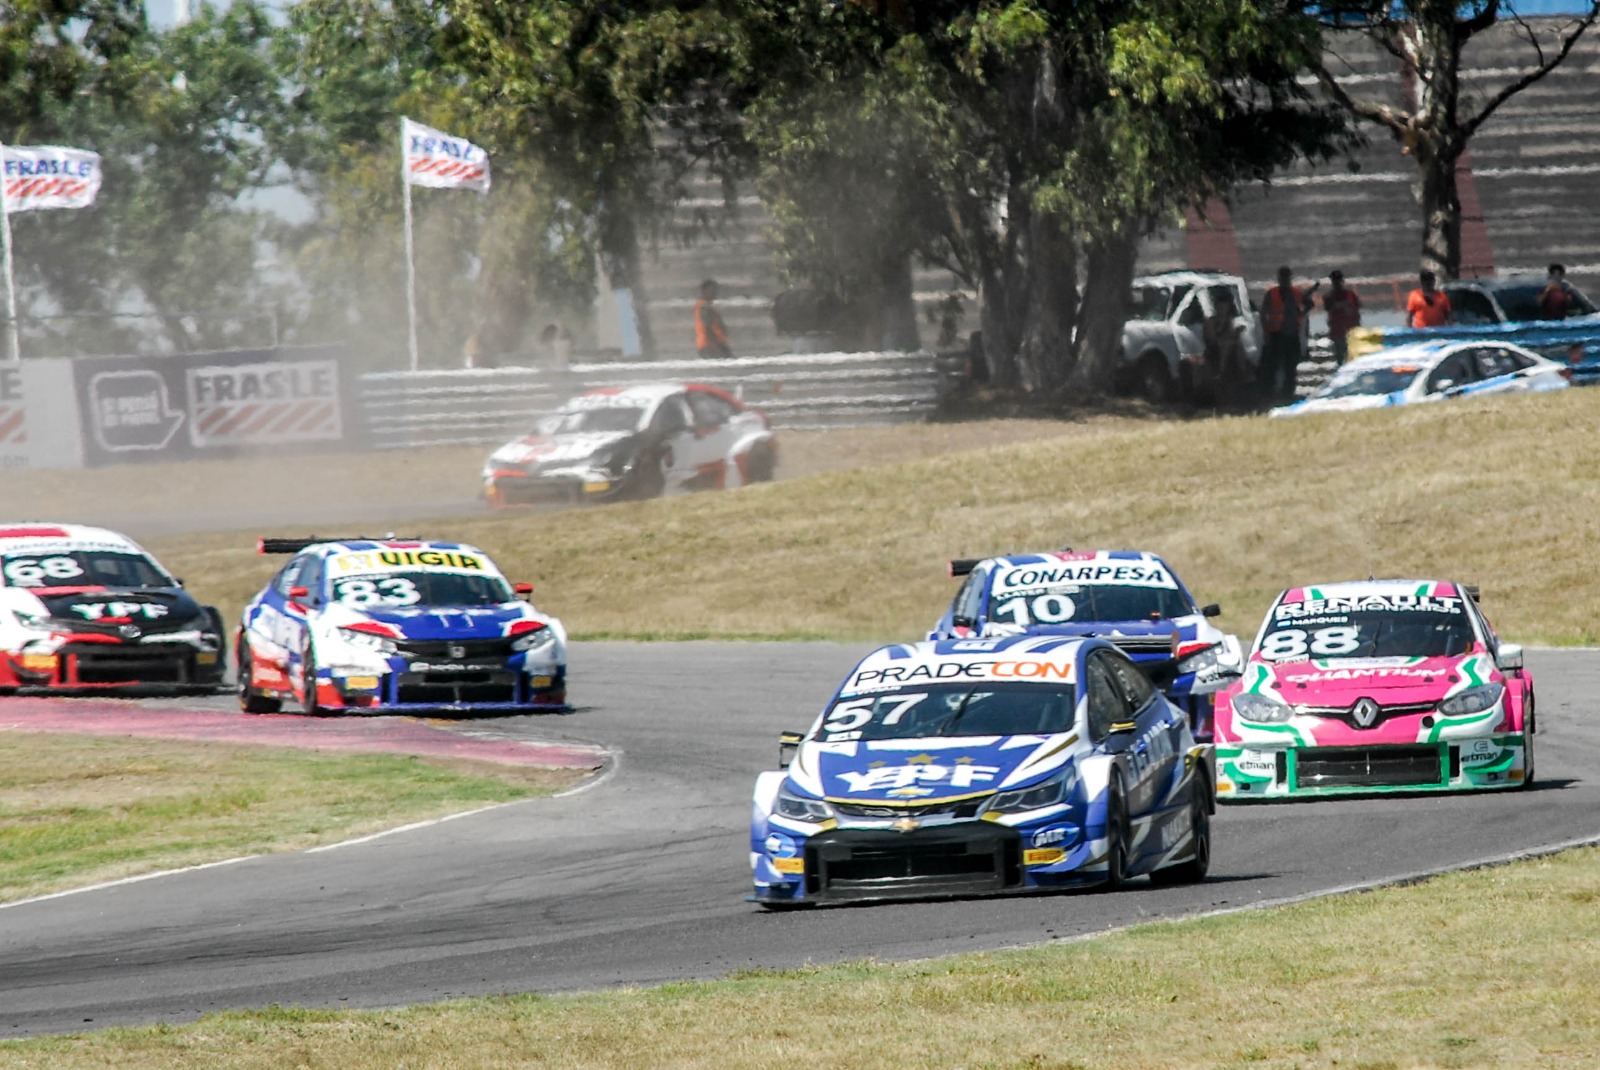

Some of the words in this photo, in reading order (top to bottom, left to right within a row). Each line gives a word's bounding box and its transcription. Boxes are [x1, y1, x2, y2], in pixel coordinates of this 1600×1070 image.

[195, 367, 334, 403] FRASLE
[4, 556, 85, 580] 68
[1004, 565, 1164, 588] CONARPESA
[337, 577, 421, 606] 83
[70, 602, 170, 620] YPF
[996, 594, 1076, 626] 10
[1276, 595, 1463, 617] RENAULT
[1260, 626, 1360, 660] 88
[853, 660, 1072, 687] PRADECON
[1285, 668, 1447, 683] QUANTIUM
[824, 692, 929, 732] 57
[836, 764, 1000, 793] YPF
